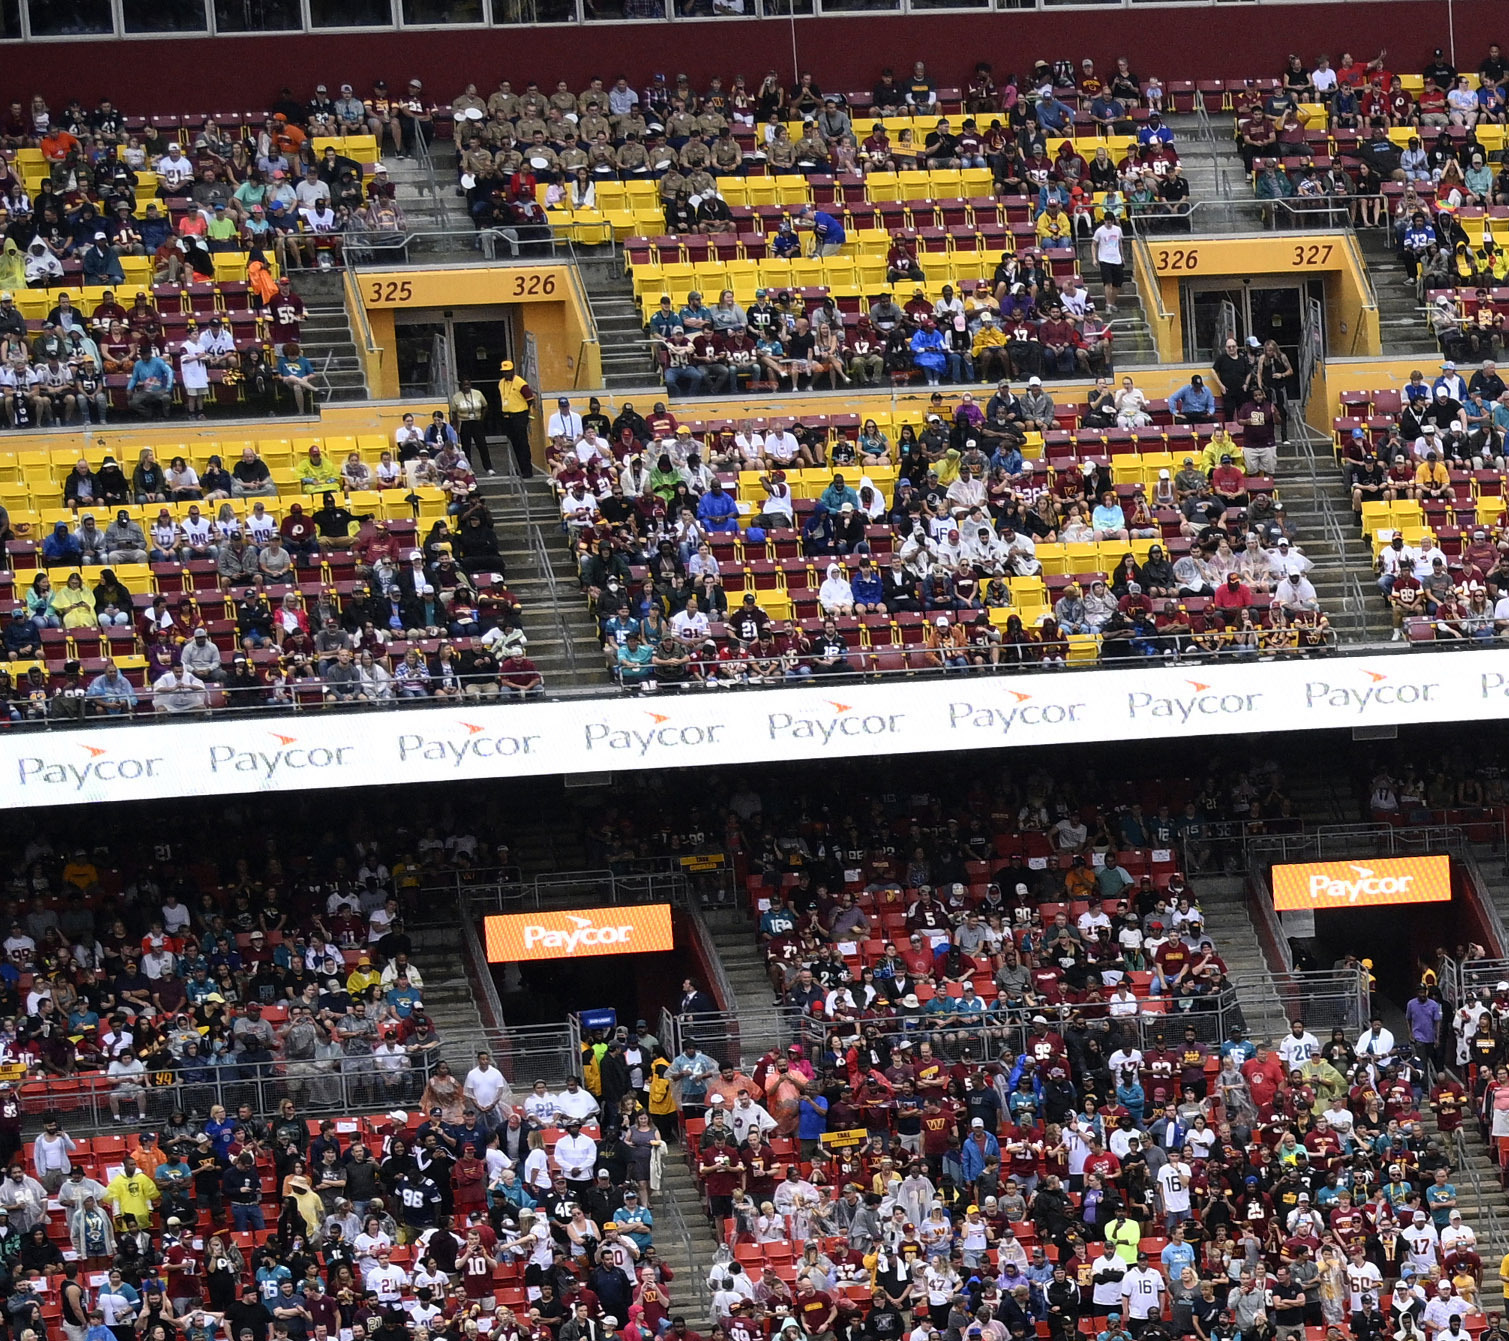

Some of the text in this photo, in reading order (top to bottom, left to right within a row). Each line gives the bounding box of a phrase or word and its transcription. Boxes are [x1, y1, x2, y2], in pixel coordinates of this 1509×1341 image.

[1157, 250, 1198, 270] 326
[1292, 245, 1333, 265] 327
[370, 283, 412, 302] 325
[513, 275, 555, 295] 326
[1129, 693, 1262, 725] Paycor
[1307, 683, 1436, 714] Paycor
[769, 713, 905, 746] Paycor
[950, 703, 1085, 735] Paycor
[400, 735, 540, 767] Paycor
[586, 725, 723, 757] Paycor
[19, 758, 161, 792] Paycor
[210, 745, 353, 780] Paycor
[1309, 875, 1413, 901] Paycor
[524, 924, 634, 953] Paycor
